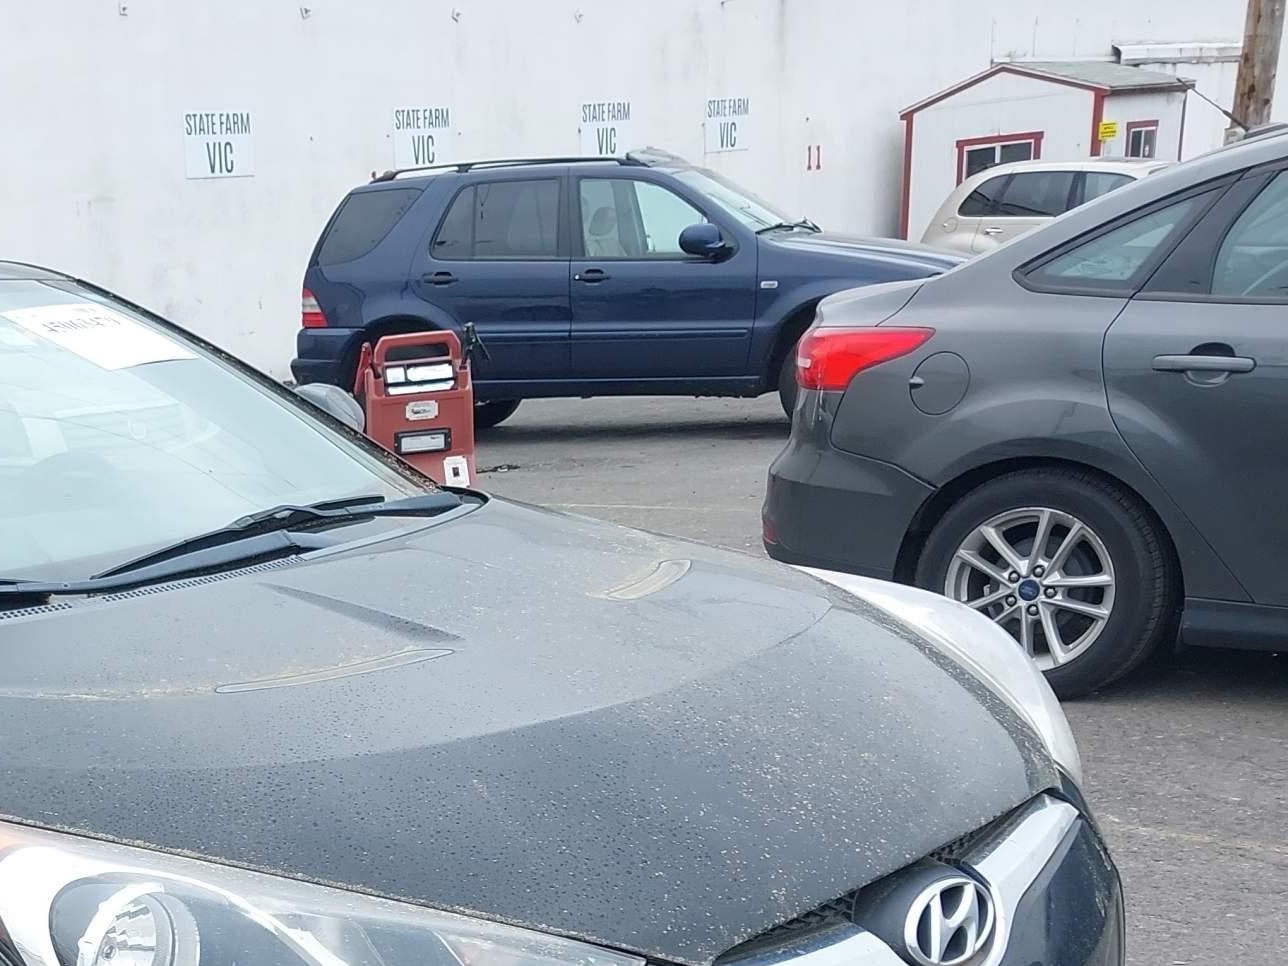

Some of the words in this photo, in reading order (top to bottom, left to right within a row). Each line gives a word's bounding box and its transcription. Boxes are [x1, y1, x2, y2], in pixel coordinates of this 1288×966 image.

[394, 108, 421, 130] STATE
[423, 107, 450, 129] FARM
[582, 103, 606, 123] STATE
[607, 101, 631, 121] FARM
[707, 99, 727, 119] STATE
[728, 97, 750, 116] FARM
[184, 113, 217, 136] STATE
[219, 112, 251, 135] FARM
[719, 121, 737, 149] VIC
[411, 134, 435, 165] VIC
[596, 127, 617, 155] VIC
[205, 141, 234, 174] VIC
[806, 144, 821, 171] 11
